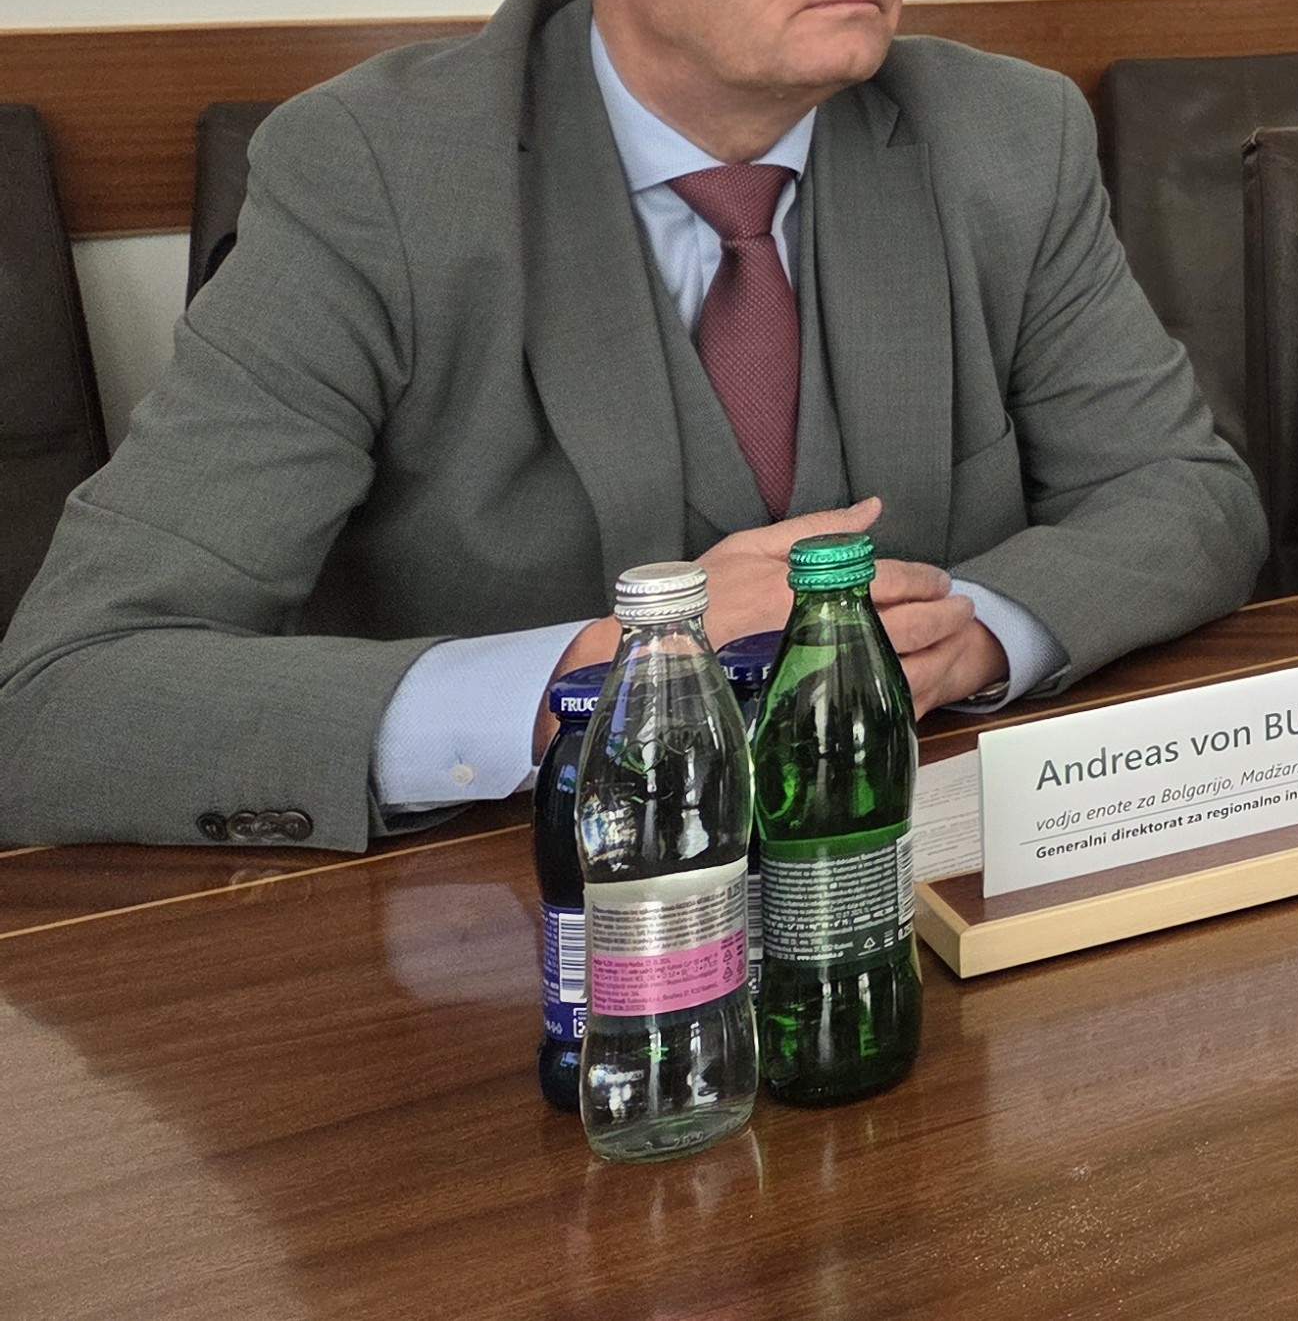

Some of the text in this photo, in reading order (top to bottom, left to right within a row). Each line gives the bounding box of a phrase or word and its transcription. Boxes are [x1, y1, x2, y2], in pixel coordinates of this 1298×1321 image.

[560, 697, 599, 712] FRUC
[1036, 740, 1179, 791] Andreas
[1190, 725, 1251, 756] von
[1036, 809, 1081, 831] vodja
[1086, 800, 1133, 821] enote
[1136, 794, 1156, 810] za
[1161, 776, 1235, 803] Bolgarijo,
[1036, 832, 1107, 859] Generalni
[1111, 816, 1184, 842] direktorat
[1187, 812, 1203, 825] za
[1206, 794, 1281, 820] regionalno
[1285, 788, 1298, 802] in
